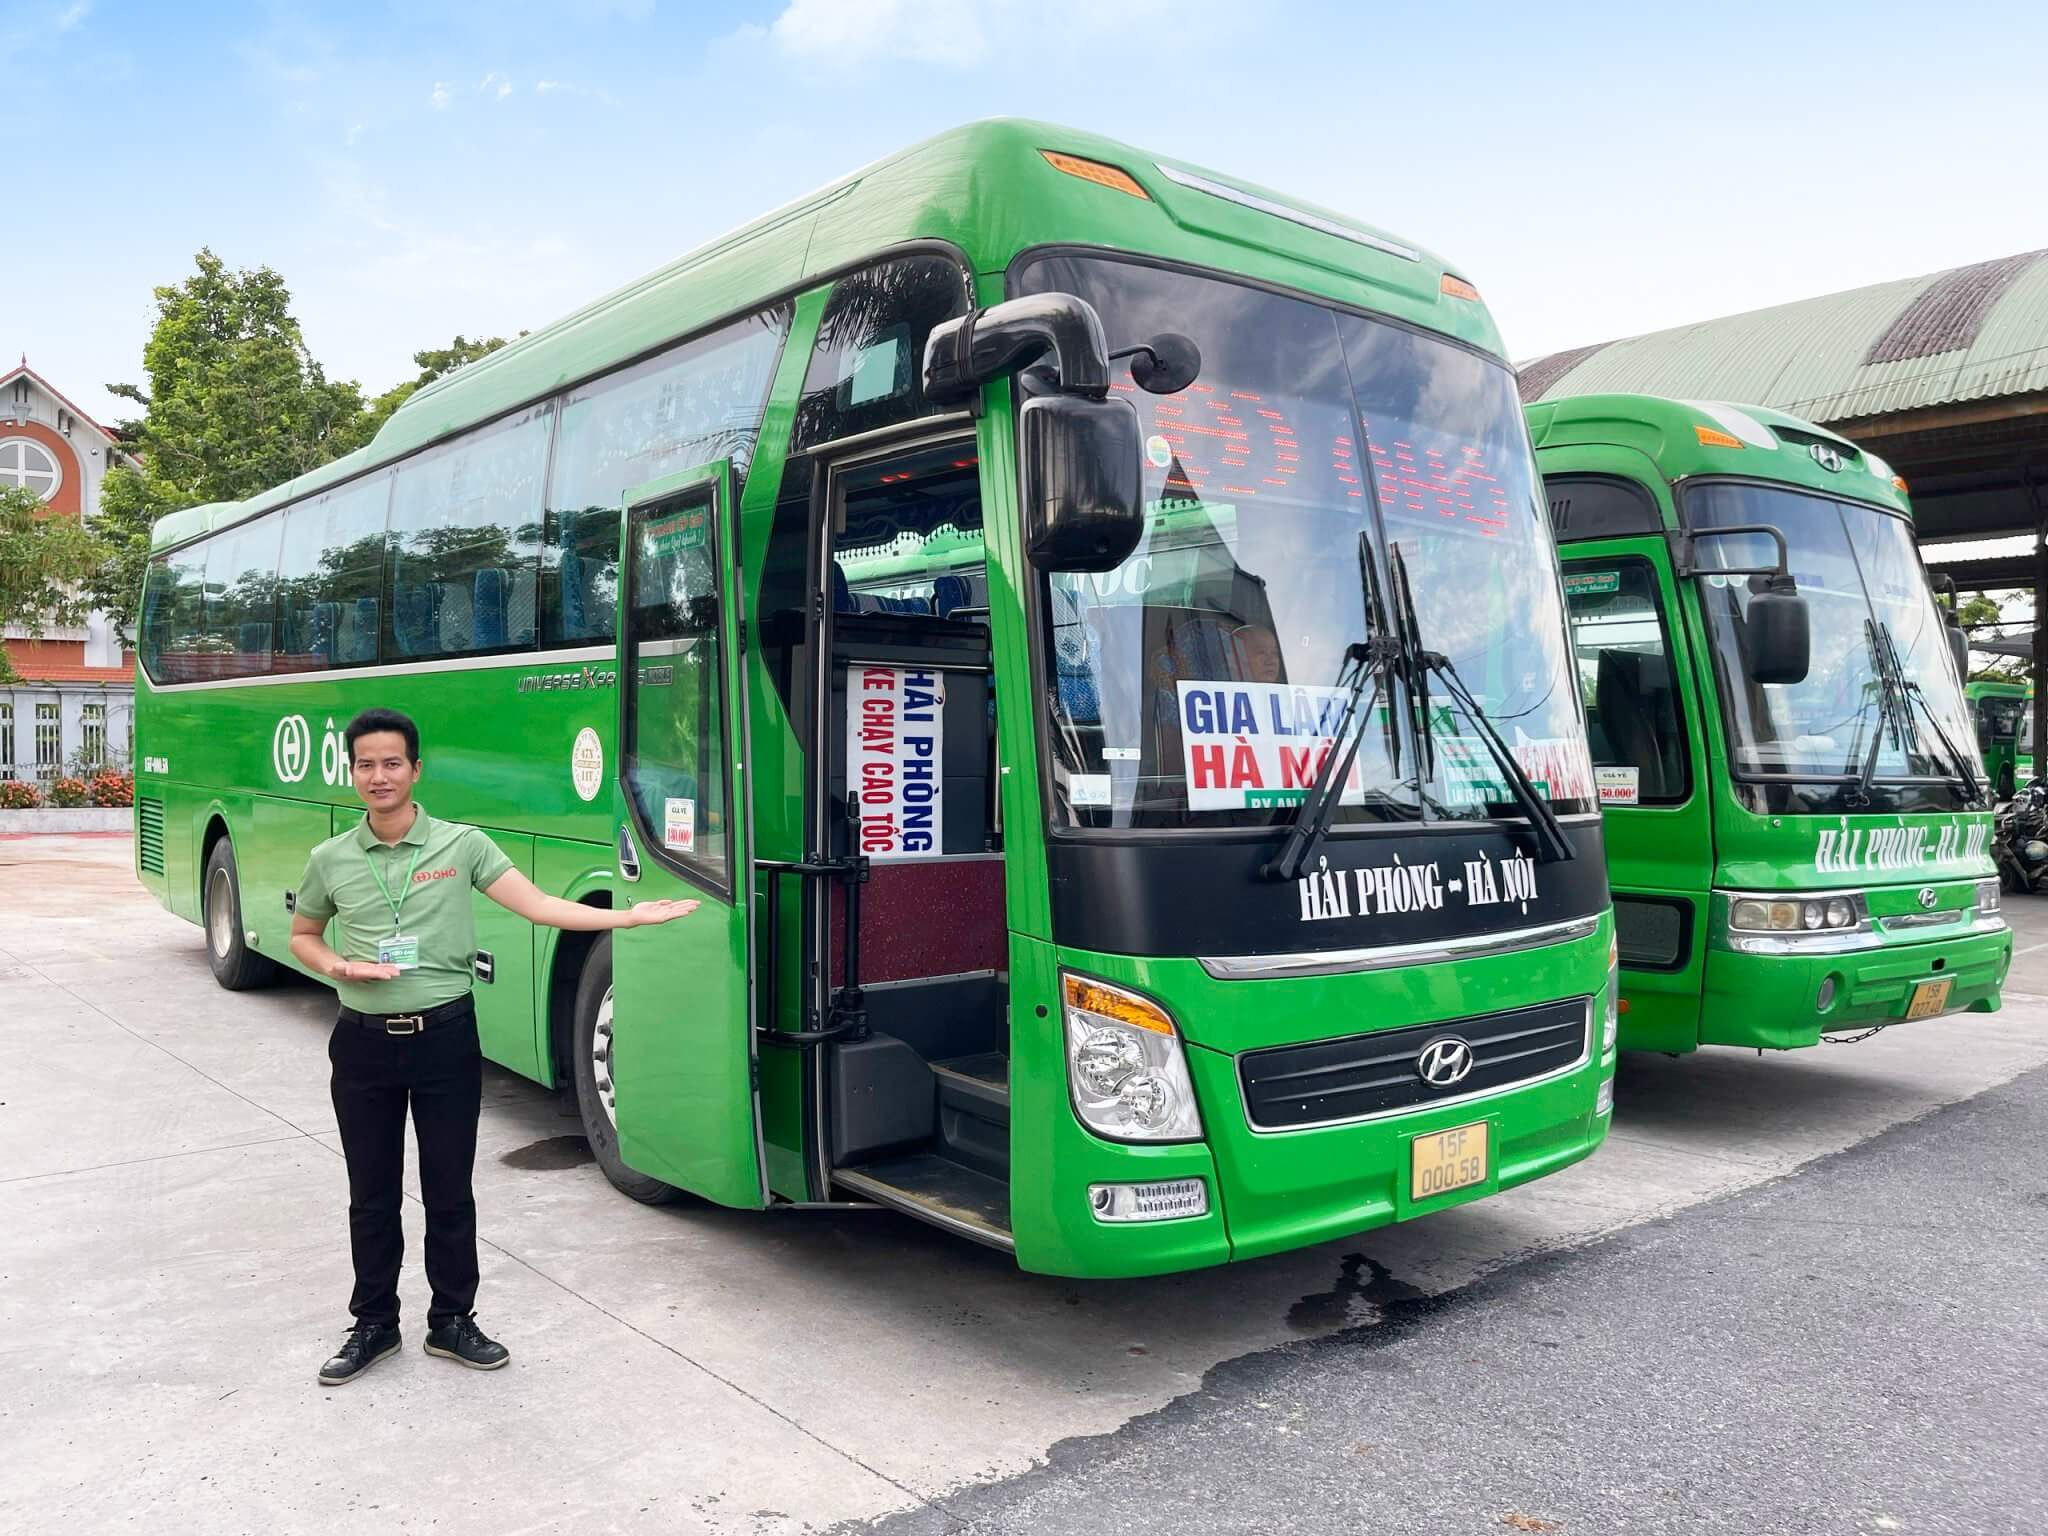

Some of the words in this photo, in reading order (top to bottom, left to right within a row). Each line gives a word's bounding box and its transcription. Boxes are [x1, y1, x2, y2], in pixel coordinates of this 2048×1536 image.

[518, 671, 580, 694] UNIVERSE
[903, 670, 943, 722] HẢI
[857, 699, 895, 755] CHẠY
[1184, 689, 1259, 735] GIA
[322, 717, 353, 787] ÔH
[1191, 736, 1264, 789] HÀ
[862, 763, 894, 804] CAO
[902, 736, 939, 852] PHÒNG
[862, 813, 903, 853] TỐC
[1815, 816, 1863, 873] HẢI
[1299, 855, 1351, 921] HẢI
[1354, 852, 1444, 917] PHÒNG
[1464, 850, 1500, 906] HÀ
[1500, 846, 1539, 916] NỘI
[1437, 1130, 1468, 1161] 15F
[1421, 1156, 1480, 1194] 000.58
